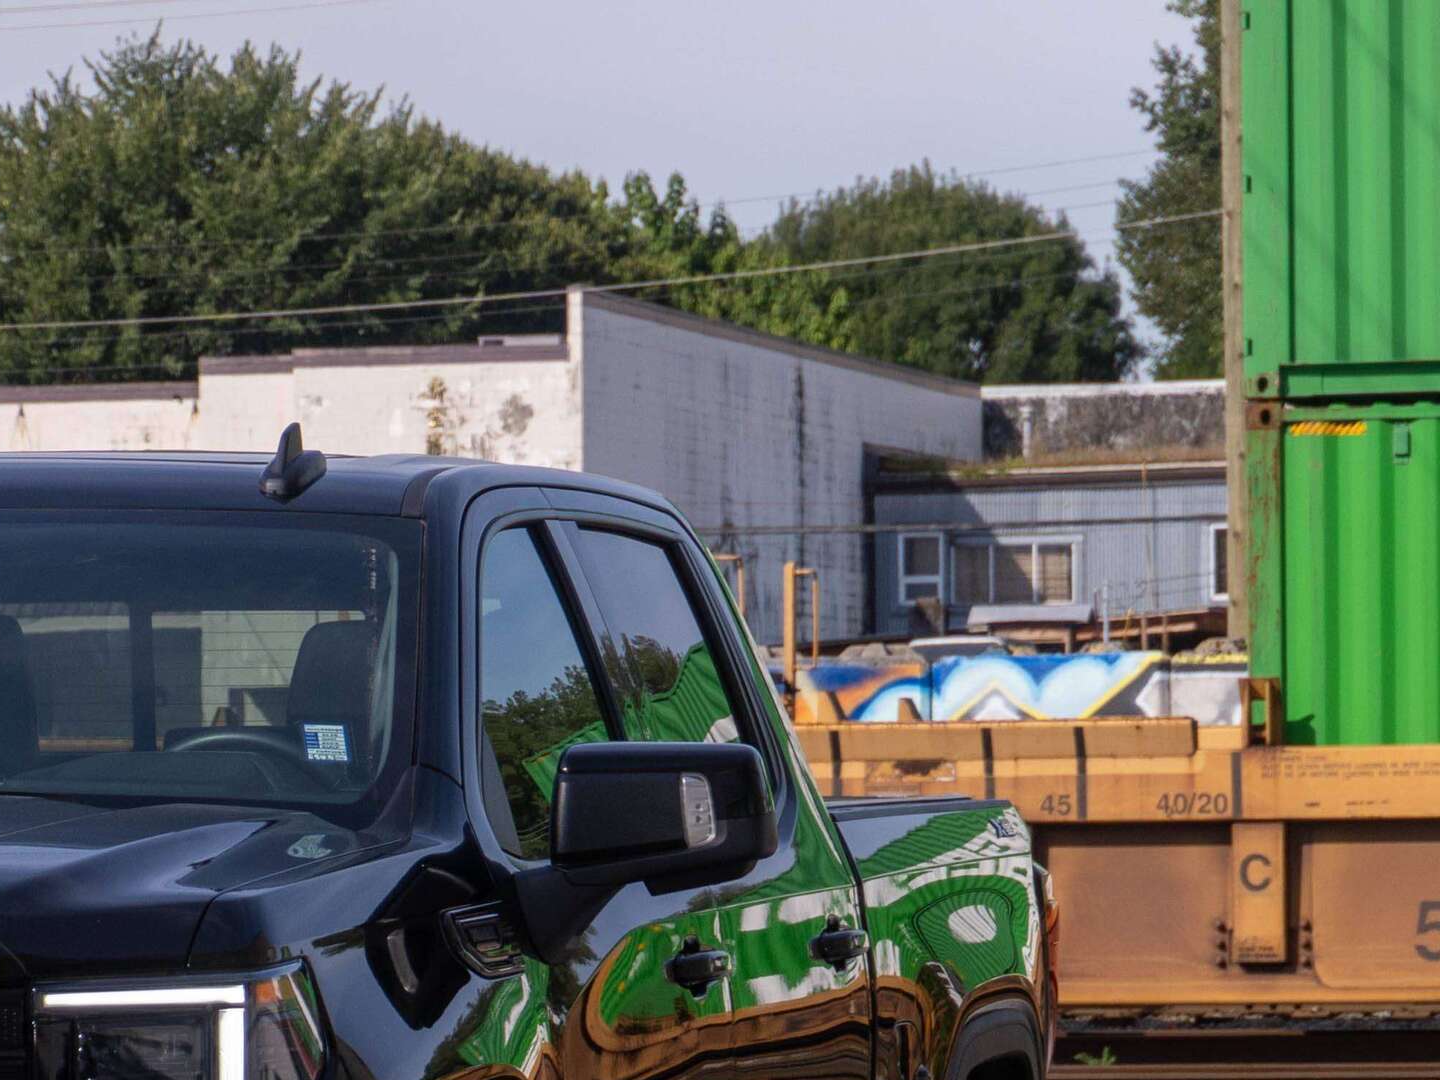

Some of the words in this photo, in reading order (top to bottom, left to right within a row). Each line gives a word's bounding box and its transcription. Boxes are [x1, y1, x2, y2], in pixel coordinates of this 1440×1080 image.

[1041, 794, 1071, 815] 45
[1157, 793, 1228, 815] 40/20
[1240, 854, 1271, 892] C
